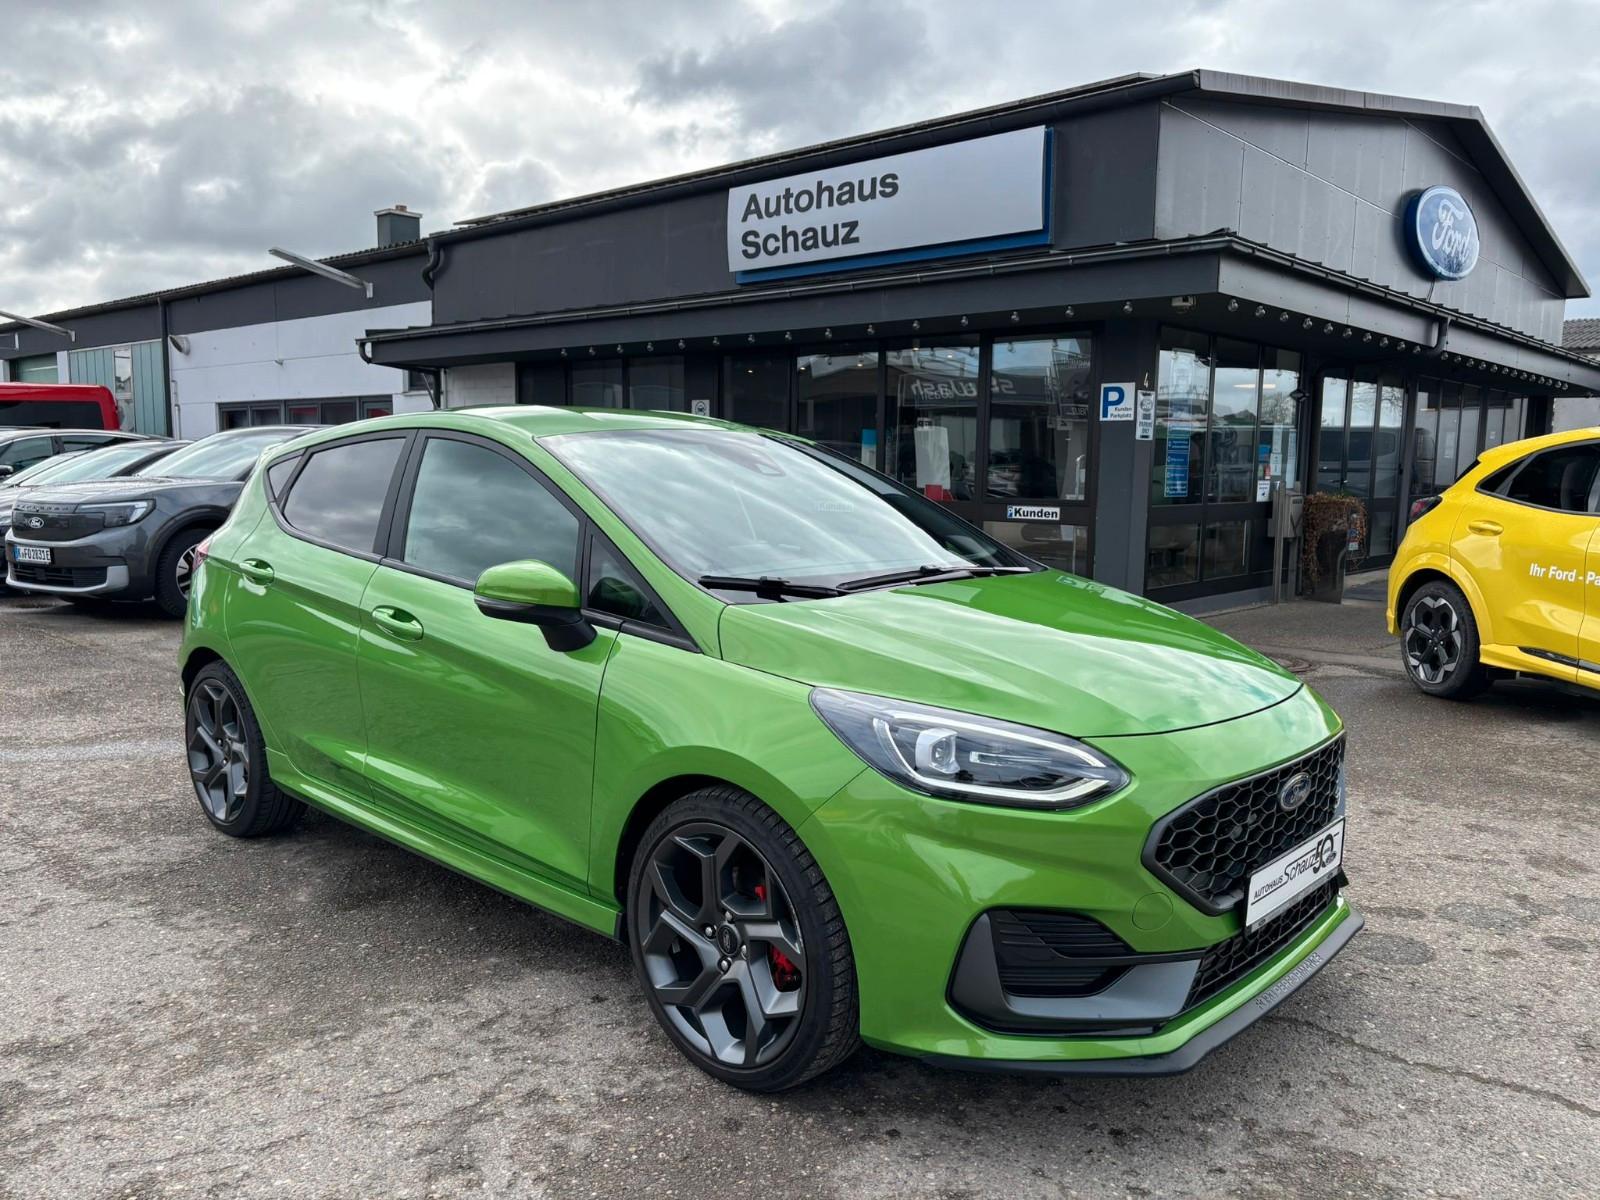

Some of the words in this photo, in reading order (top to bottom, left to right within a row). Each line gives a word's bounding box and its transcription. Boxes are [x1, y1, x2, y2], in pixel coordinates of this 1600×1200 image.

[741, 173, 899, 222] Autohaus
[741, 220, 860, 259] Schauz
[1432, 199, 1471, 263] Ford
[1102, 386, 1125, 418] P
[1014, 507, 1058, 519] Kunden
[1529, 562, 1546, 577] Ihr
[1548, 565, 1577, 582] Ford
[1253, 875, 1284, 900] AUTOHAUS
[1284, 853, 1320, 884] Schauz
